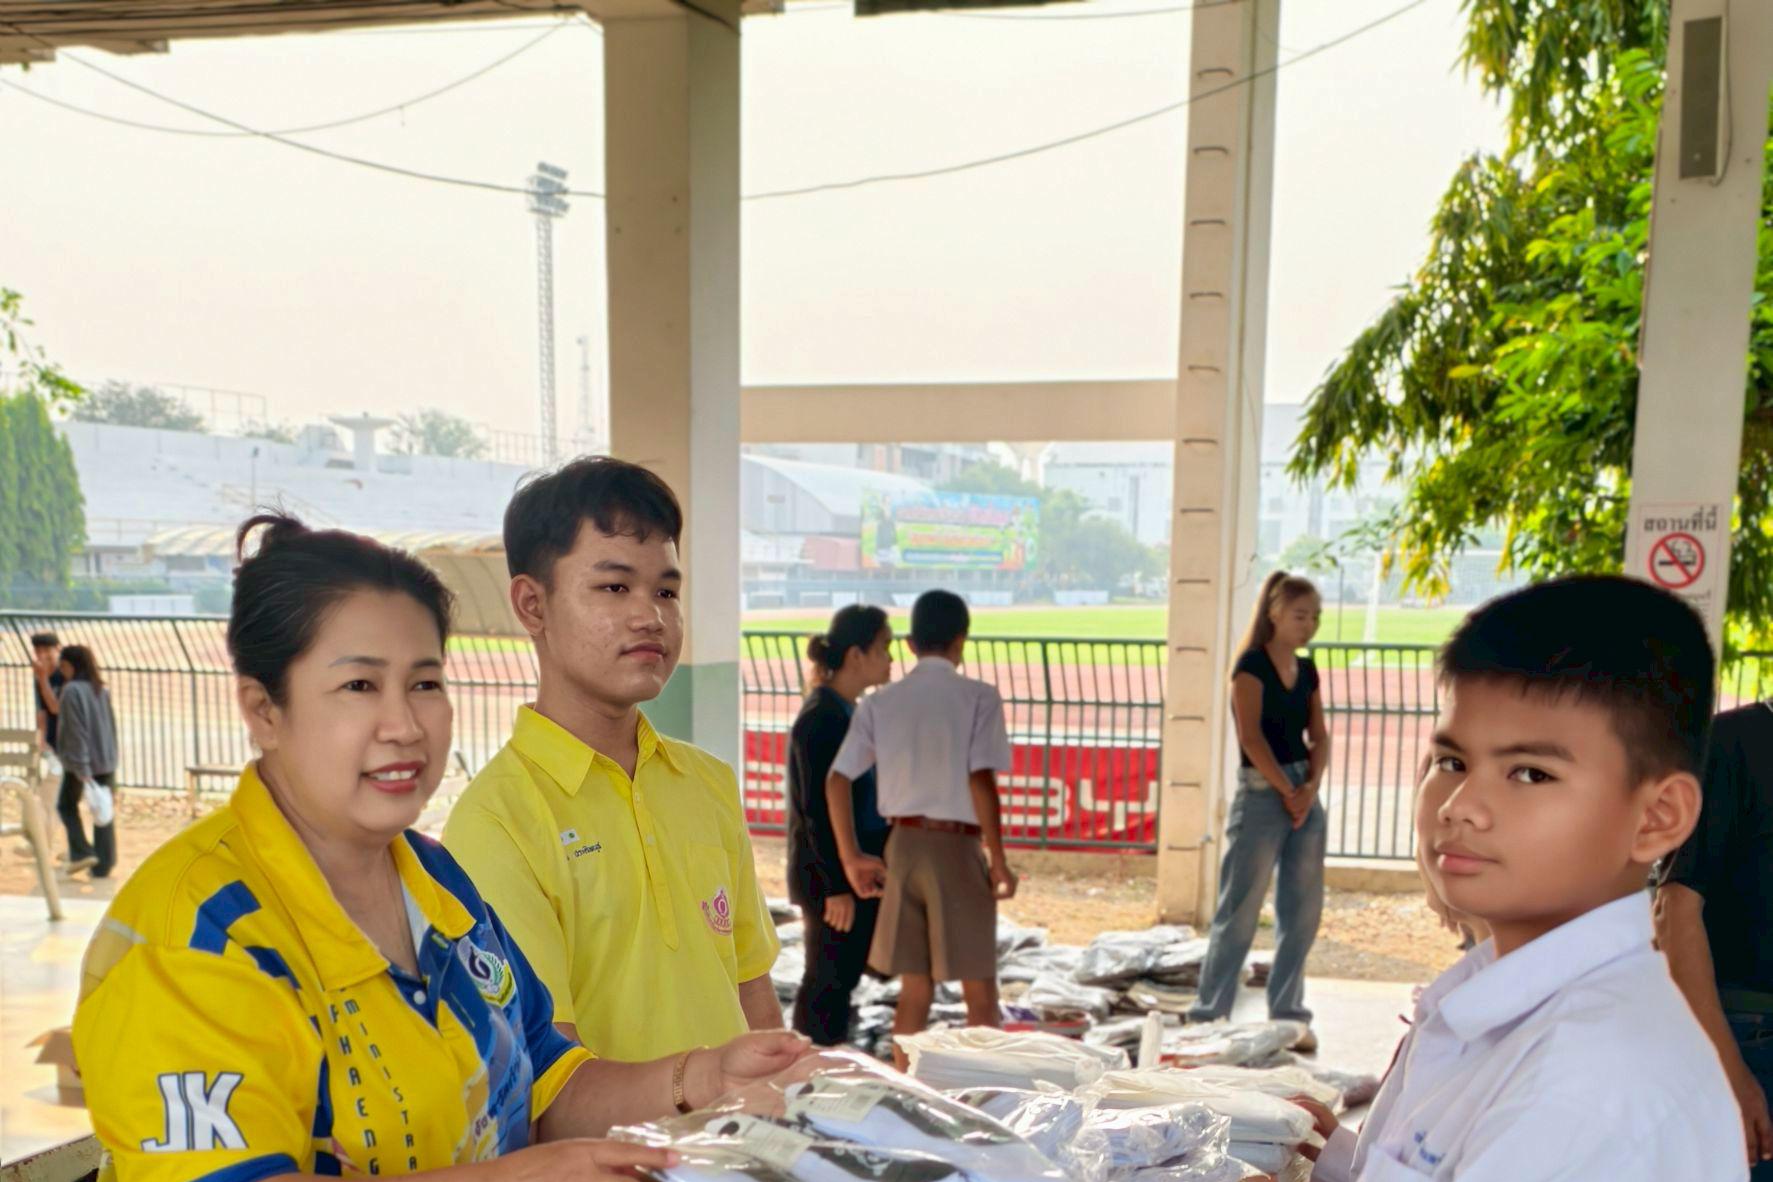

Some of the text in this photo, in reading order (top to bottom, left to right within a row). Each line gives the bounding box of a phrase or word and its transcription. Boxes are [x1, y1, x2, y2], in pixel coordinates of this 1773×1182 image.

[1644, 505, 1718, 531] สถานที่นี้
[141, 1071, 249, 1152] JK
